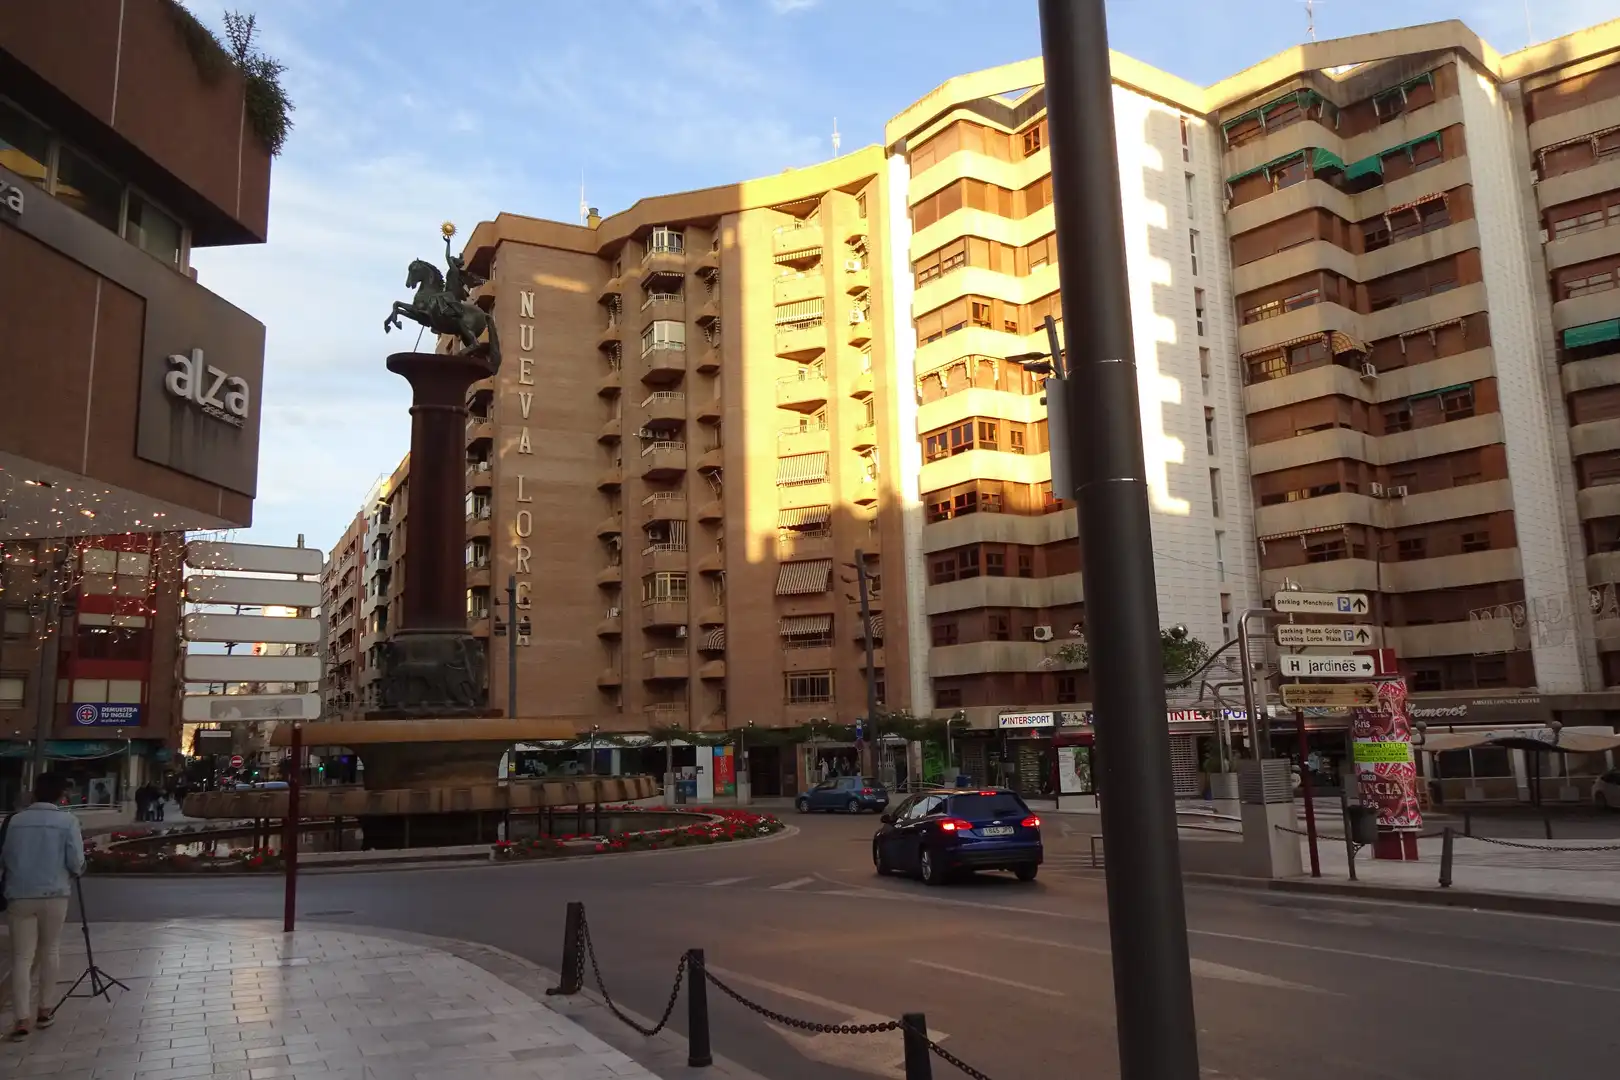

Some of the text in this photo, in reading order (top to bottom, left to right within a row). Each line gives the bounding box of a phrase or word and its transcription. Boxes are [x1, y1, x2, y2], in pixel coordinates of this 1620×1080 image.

[165, 348, 250, 419] alza
[518, 290, 535, 455] NUEVA
[1290, 660, 1356, 674] H jardines
[1007, 715, 1050, 725] INTERSPORT
